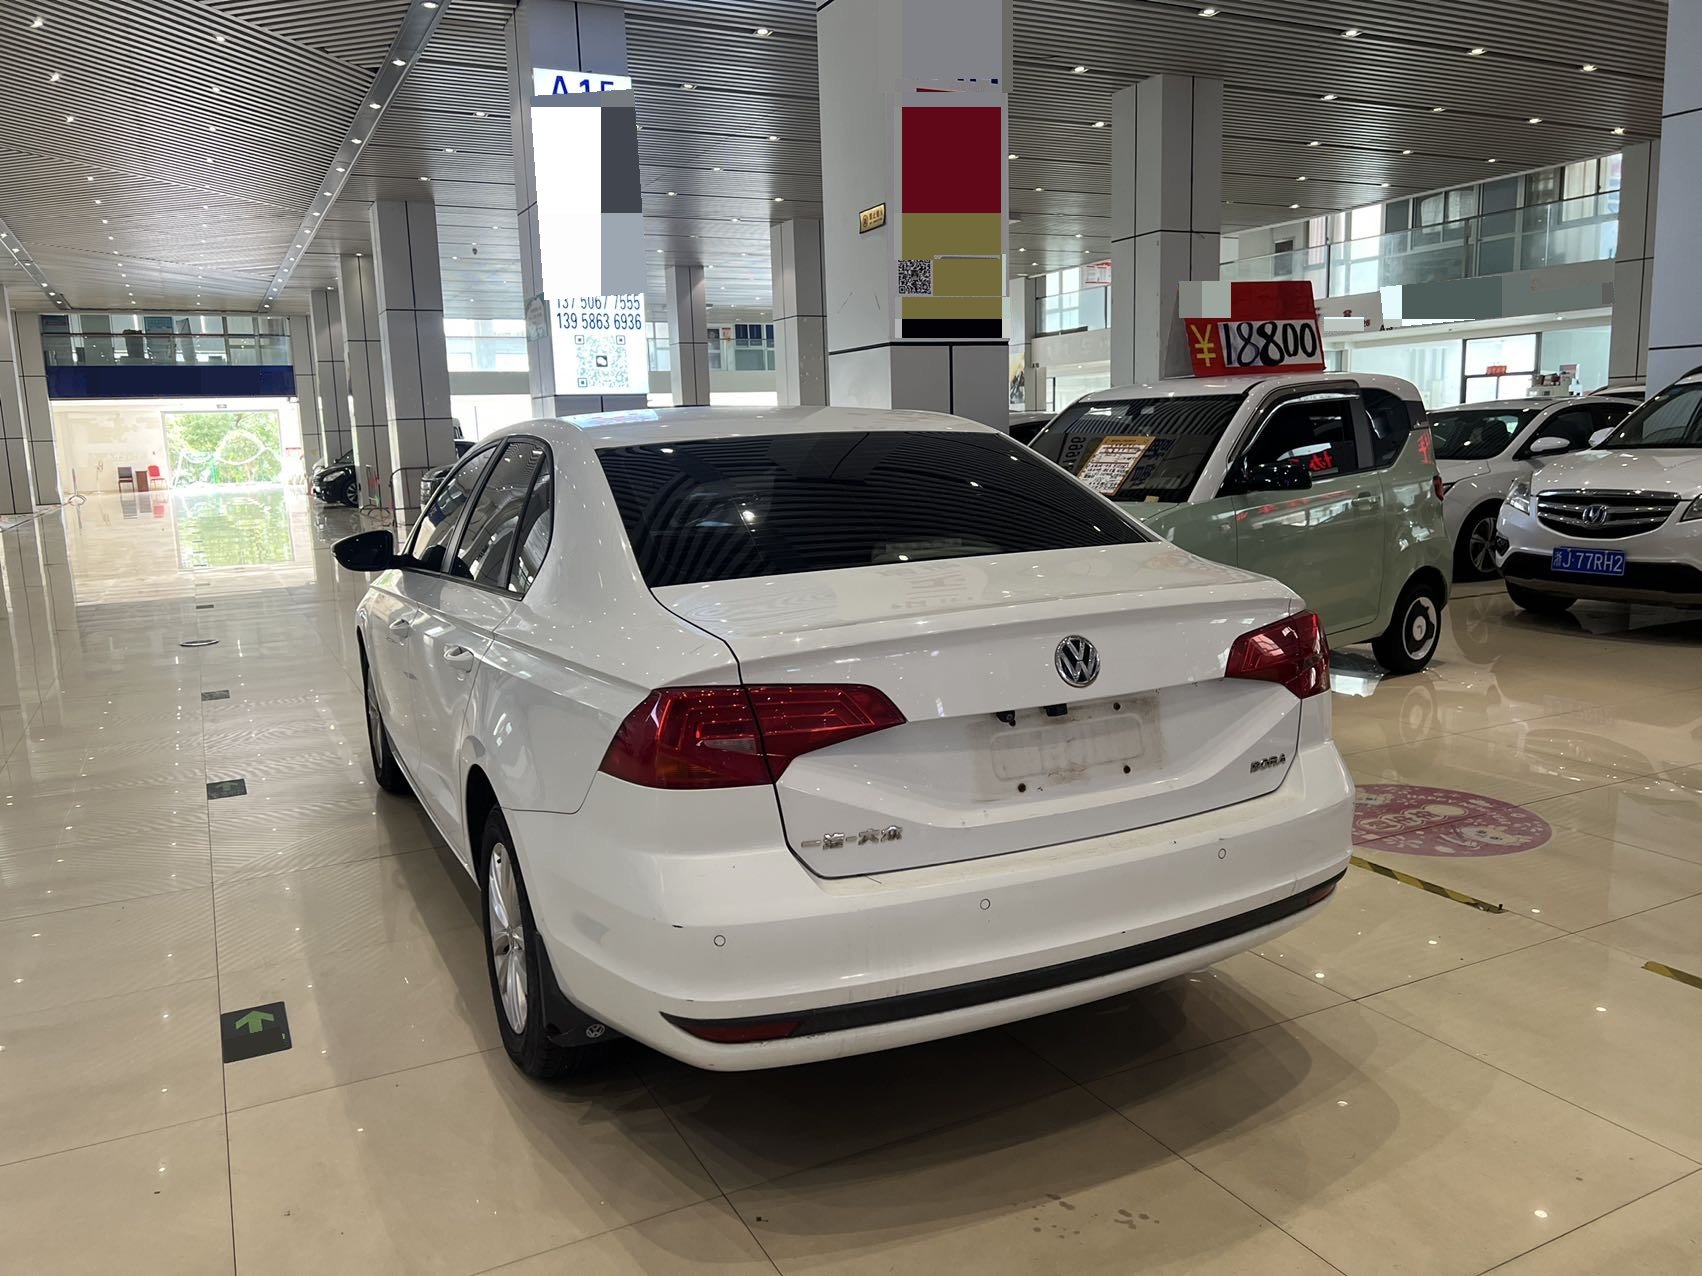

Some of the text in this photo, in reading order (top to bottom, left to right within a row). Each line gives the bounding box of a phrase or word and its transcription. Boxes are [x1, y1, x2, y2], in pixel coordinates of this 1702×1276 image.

[556, 312, 578, 329] 139
[581, 312, 610, 330] 5863
[613, 313, 642, 330] 6936
